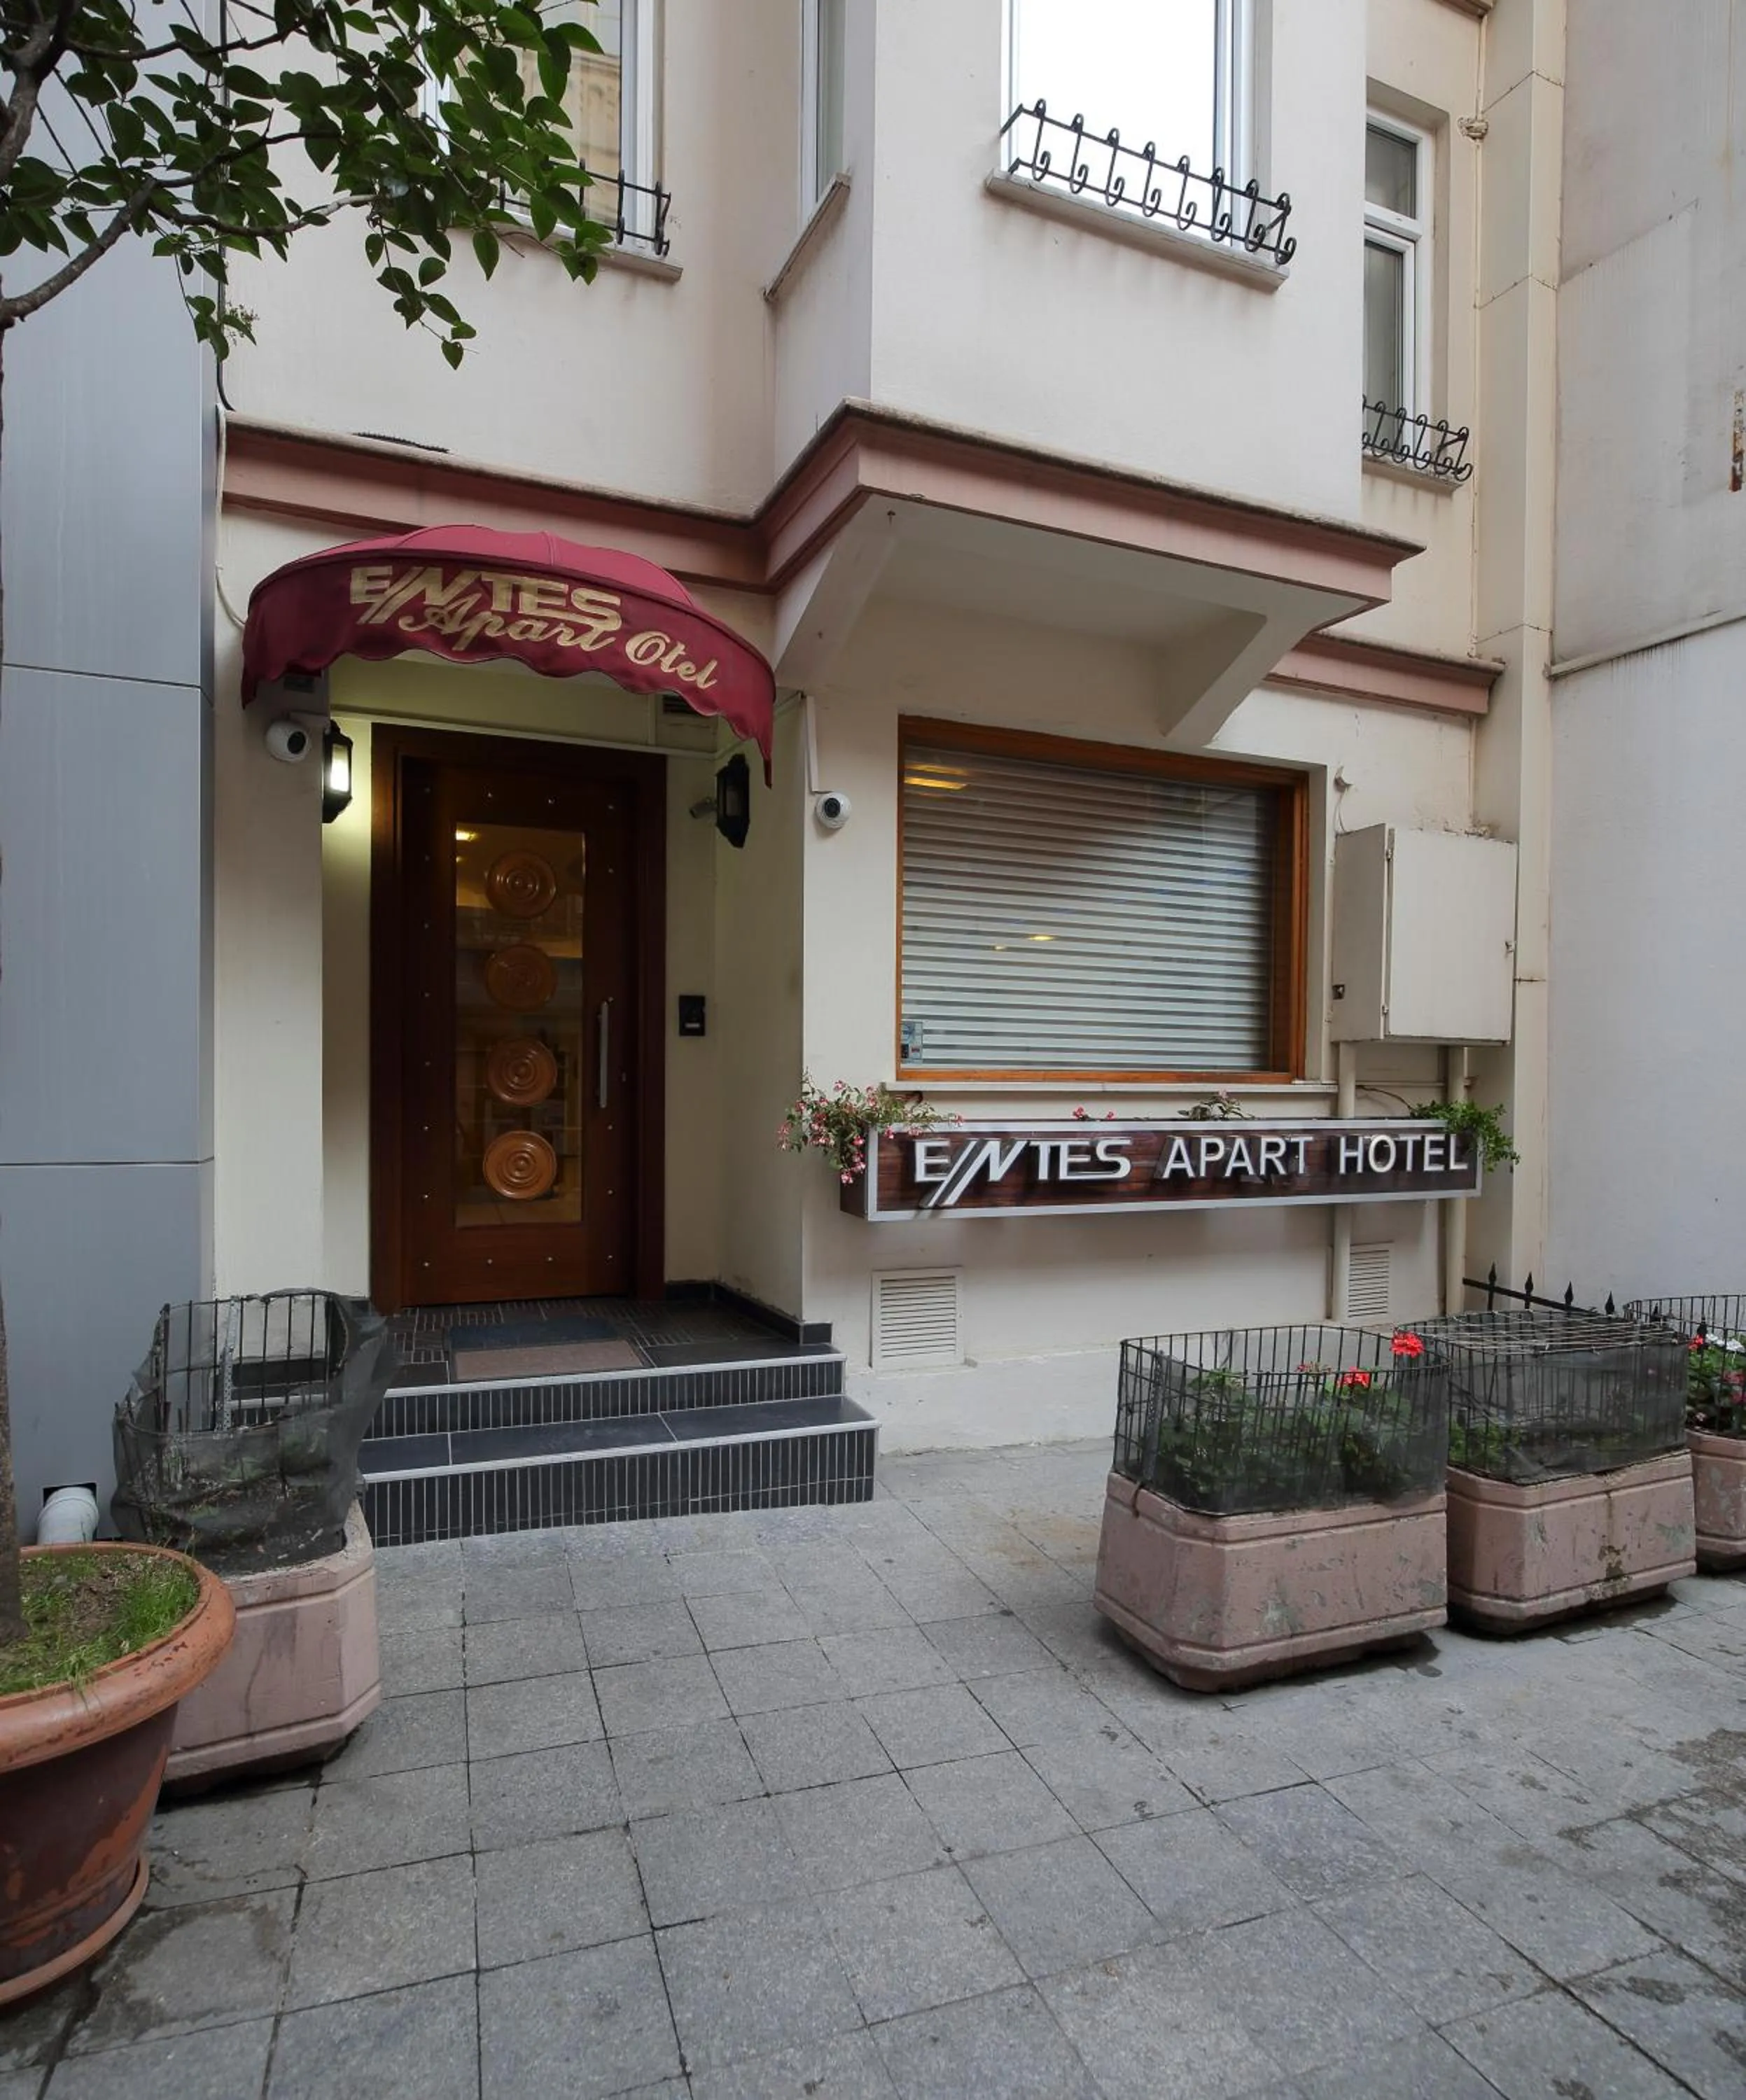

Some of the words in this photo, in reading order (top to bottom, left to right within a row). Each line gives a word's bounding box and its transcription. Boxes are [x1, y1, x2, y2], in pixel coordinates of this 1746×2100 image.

[398, 593, 616, 650] Apart
[625, 631, 718, 690] Otel
[1162, 1136, 1313, 1179] APART
[1339, 1133, 1468, 1174] HOTEL
